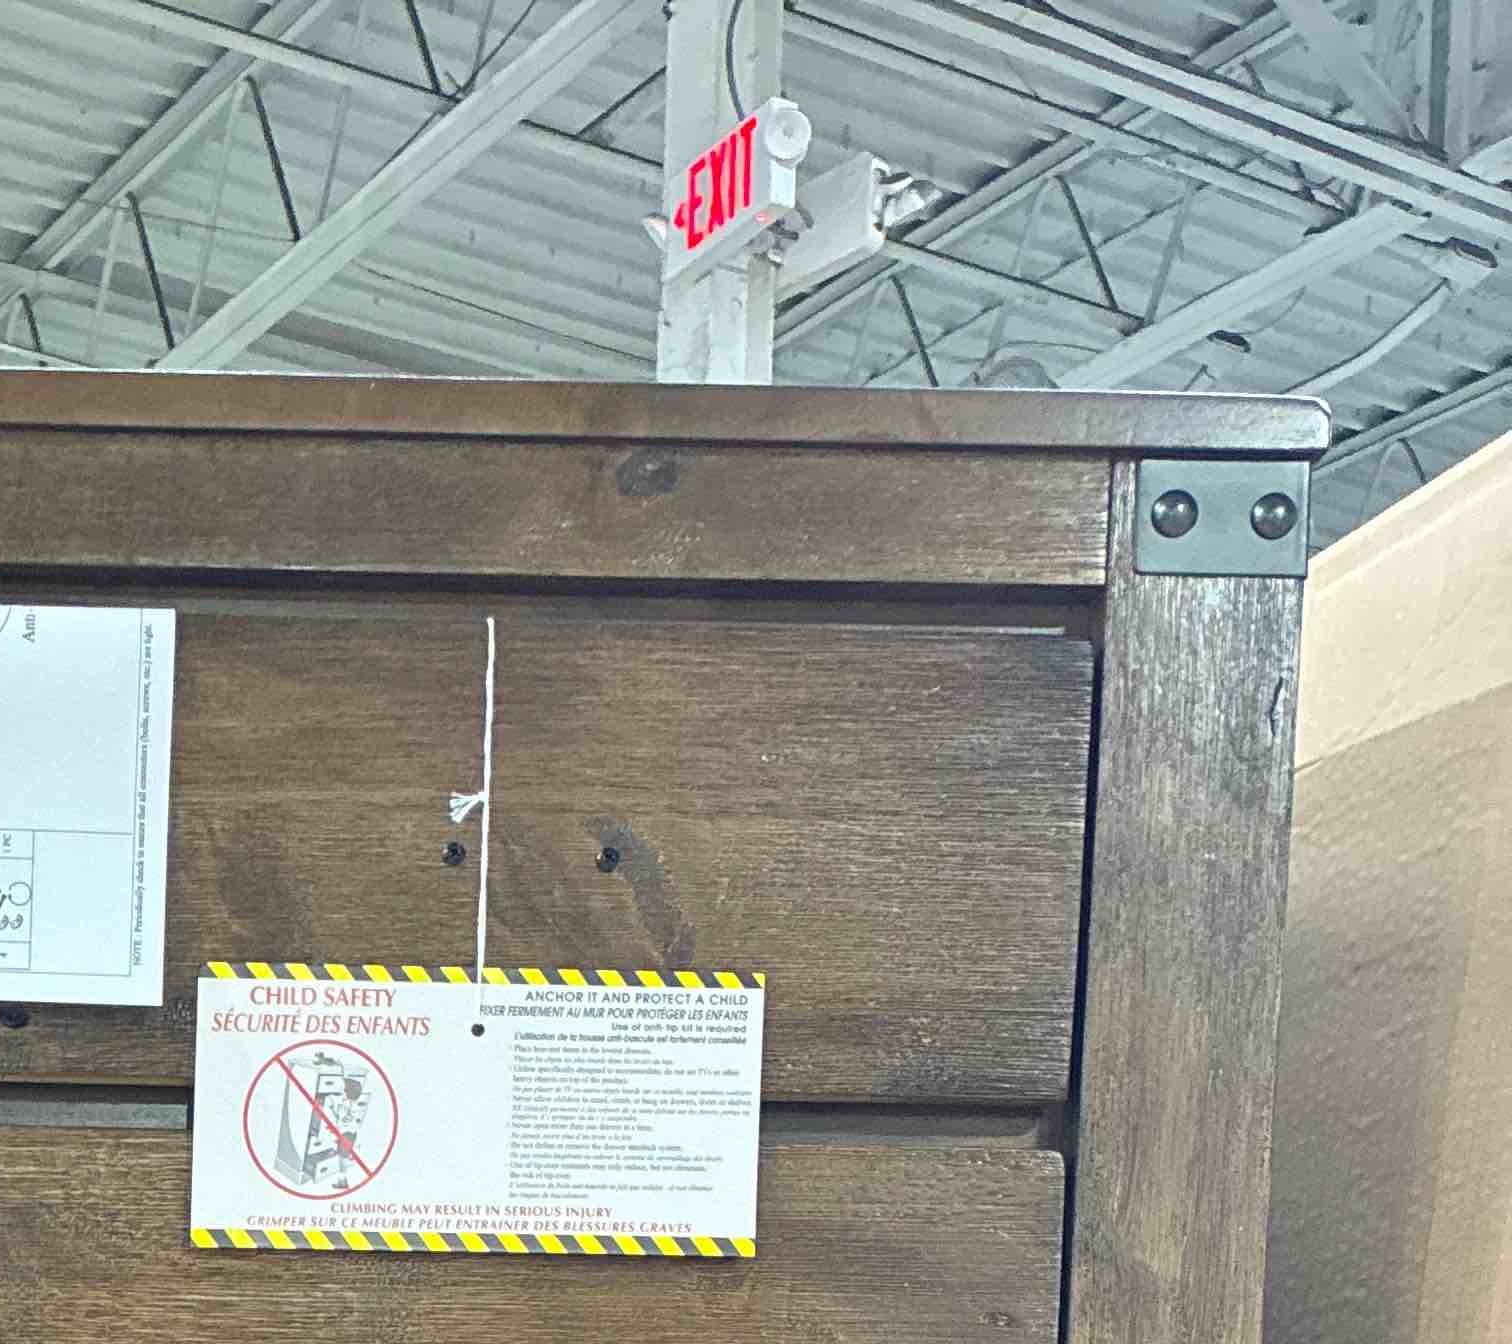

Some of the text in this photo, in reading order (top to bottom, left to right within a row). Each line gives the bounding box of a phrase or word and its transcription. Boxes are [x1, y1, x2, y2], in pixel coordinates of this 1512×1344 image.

[688, 115, 758, 250] EXIT
[138, 792, 146, 802] all
[2, 833, 12, 846] PC
[136, 860, 144, 883] check
[134, 886, 146, 932] Periodically
[133, 940, 143, 966] NOTE
[250, 985, 397, 1007] CHILD SAFETY
[524, 990, 748, 1006] ANCHOR IT AND PROTECT A CHILD
[211, 1006, 431, 1037] SÉCURITÉ DES ENFANTS
[479, 1004, 505, 1017] FIXER
[507, 1005, 565, 1017] FERMEMENT
[566, 1007, 581, 1018] AU
[582, 1007, 605, 1019] MUR
[607, 1007, 634, 1019] POUR
[688, 1009, 703, 1020] LES
[705, 1009, 748, 1021] ENFANTS
[557, 1033, 568, 1041] de
[631, 1023, 642, 1031] of
[695, 1024, 703, 1032] is
[705, 1024, 747, 1033] required
[331, 1203, 613, 1218] CLIMBING MAY RESULT IN SERIOUS INJURY
[247, 1215, 306, 1227] GRIMPER
[311, 1216, 337, 1228] SUR
[341, 1217, 359, 1228] CE
[361, 1217, 415, 1229] MEUBLE
[419, 1218, 450, 1230] PEUT
[534, 1219, 559, 1231] DES
[563, 1221, 635, 1233] BLESSURES
[639, 1222, 693, 1234] GRAVES
